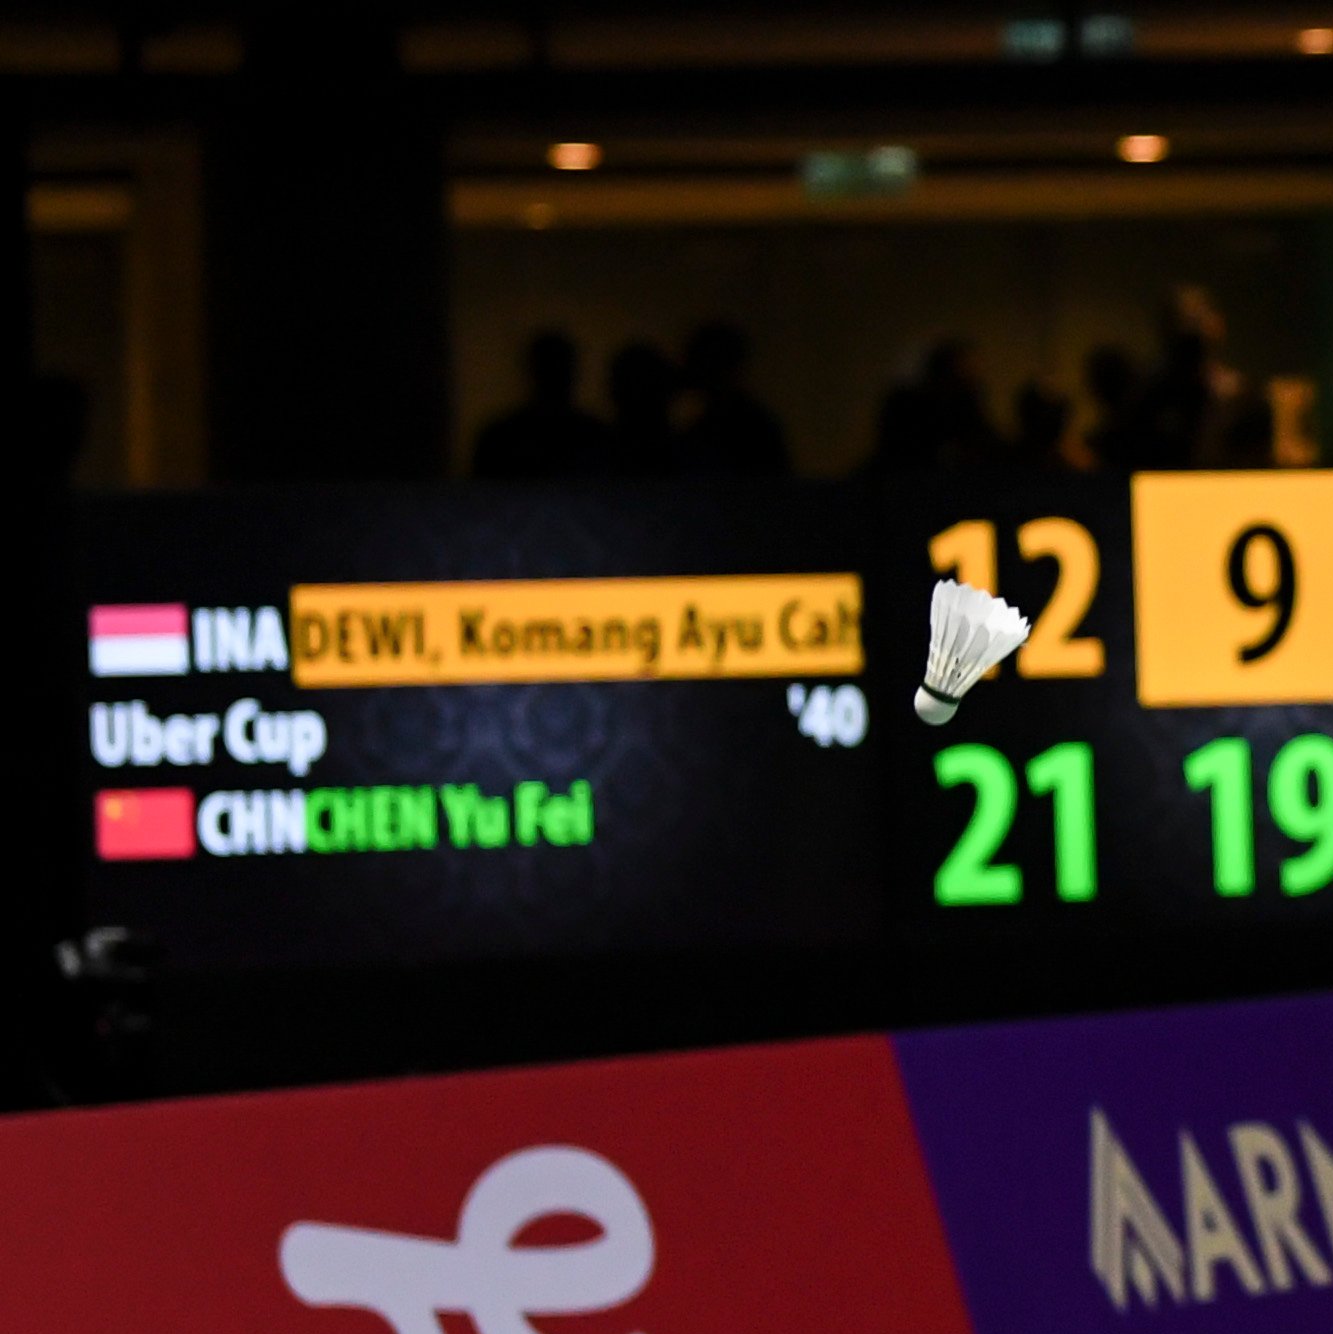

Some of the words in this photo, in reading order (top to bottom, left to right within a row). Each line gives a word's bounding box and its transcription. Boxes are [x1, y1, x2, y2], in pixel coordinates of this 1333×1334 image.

[1223, 522, 1299, 665] 9
[192, 605, 289, 672] INA
[299, 608, 443, 672] DEWI,
[457, 604, 662, 677] Komang
[677, 602, 763, 676] Ayu
[89, 699, 220, 768] Uber
[223, 697, 328, 777] Cup
[197, 789, 305, 857] CHN
[305, 786, 437, 854] CHEN
[440, 782, 510, 849] Yu
[513, 778, 596, 848] Fei
[932, 740, 1098, 908] 21
